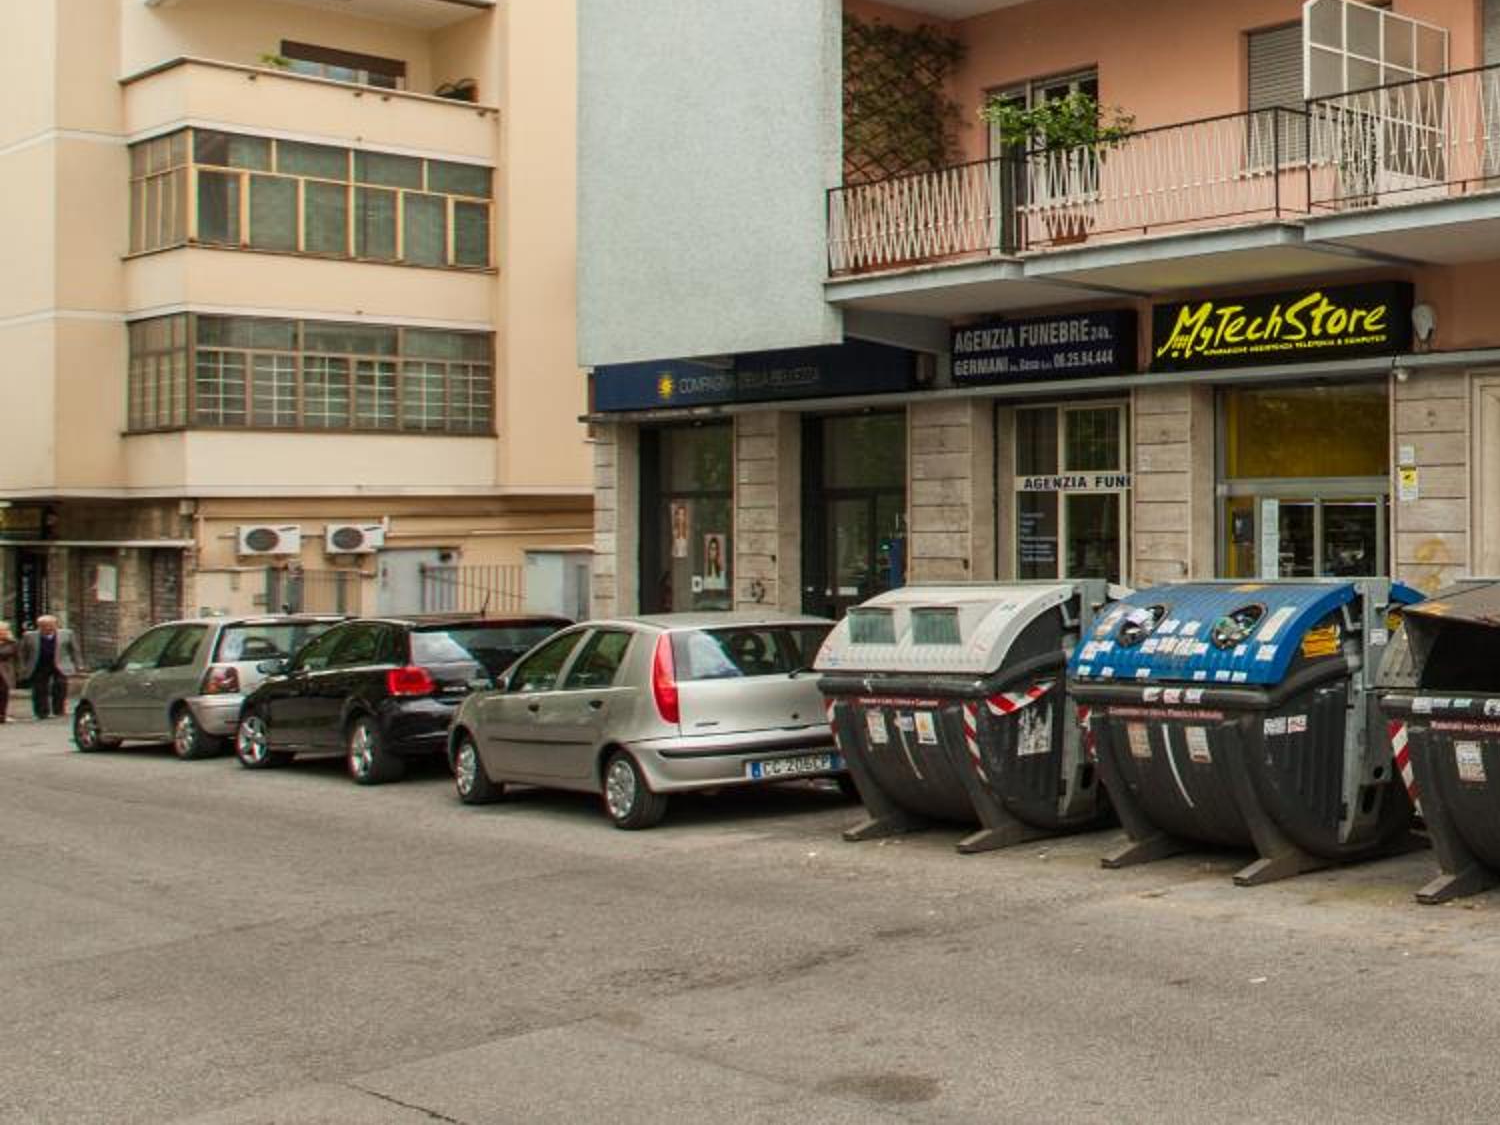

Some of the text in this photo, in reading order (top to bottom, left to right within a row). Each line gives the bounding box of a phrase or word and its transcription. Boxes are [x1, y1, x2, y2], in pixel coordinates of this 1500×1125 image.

[954, 327, 1015, 354] AGENZIA
[1019, 319, 1090, 348] FUNEBRE
[1157, 292, 1387, 358] MyTechStore
[954, 357, 1009, 376] GERMANI
[1023, 476, 1088, 490] AGENZIA
